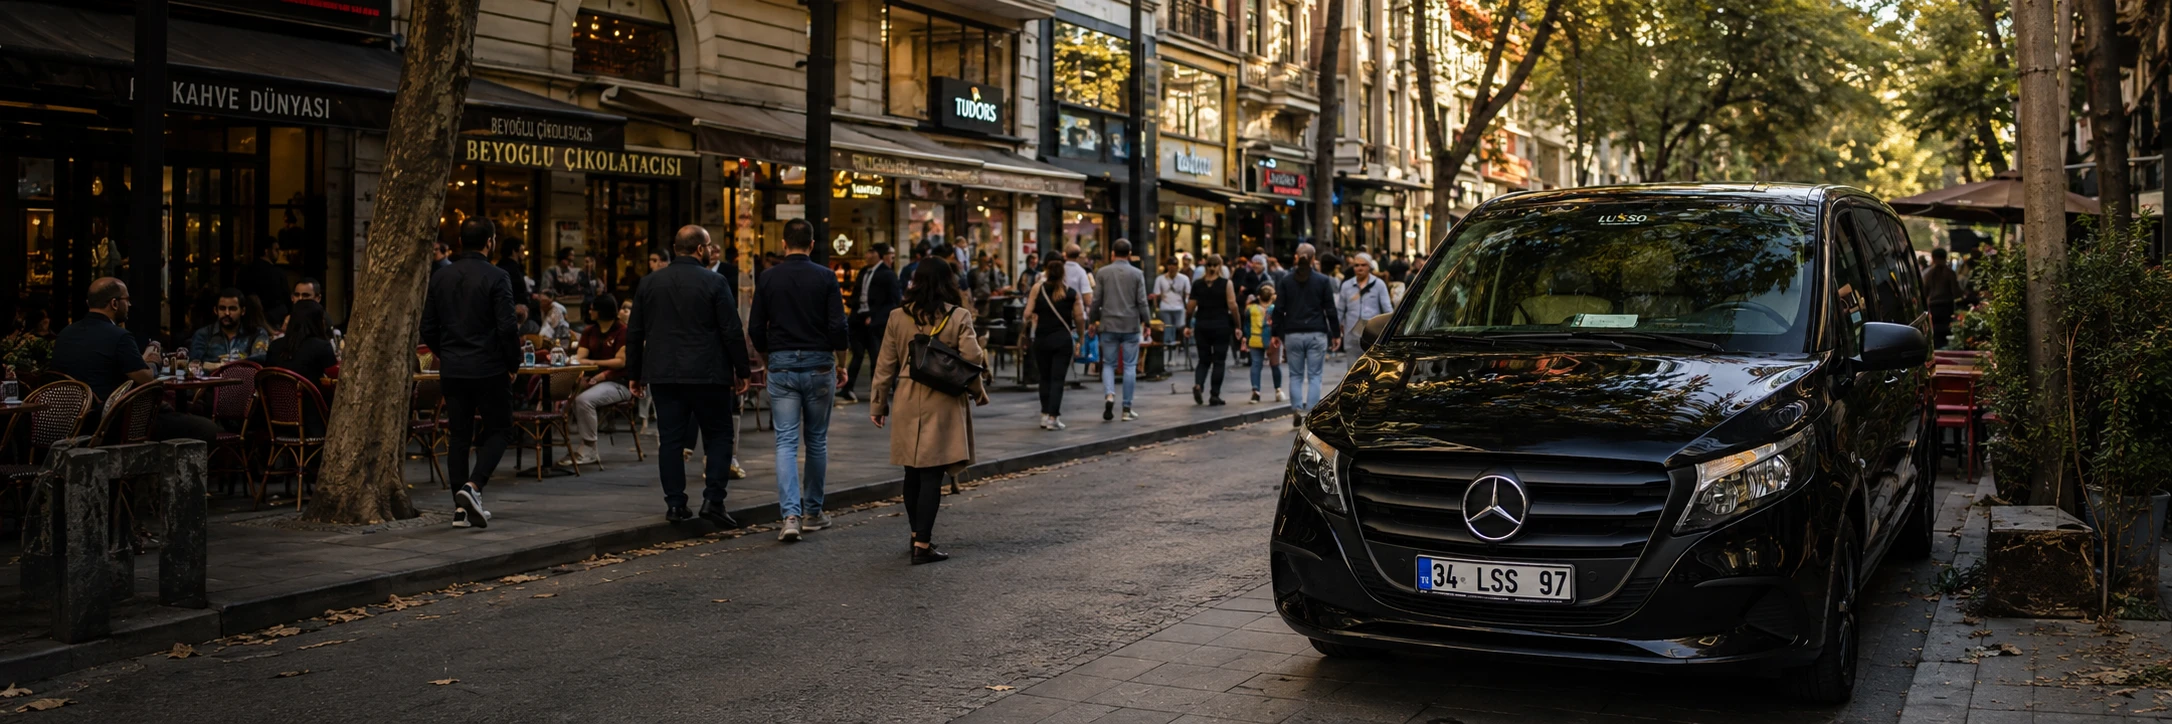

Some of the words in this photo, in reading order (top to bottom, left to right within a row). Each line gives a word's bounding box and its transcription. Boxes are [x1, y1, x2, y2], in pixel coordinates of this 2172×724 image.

[172, 81, 240, 110] KAHVE
[250, 87, 330, 119] DÜNYASI
[955, 97, 997, 122] TUDORS
[1598, 213, 1647, 223] LUSSO
[1433, 563, 1458, 589] 34
[1477, 567, 1518, 593] LSS
[1539, 571, 1567, 596] 97
